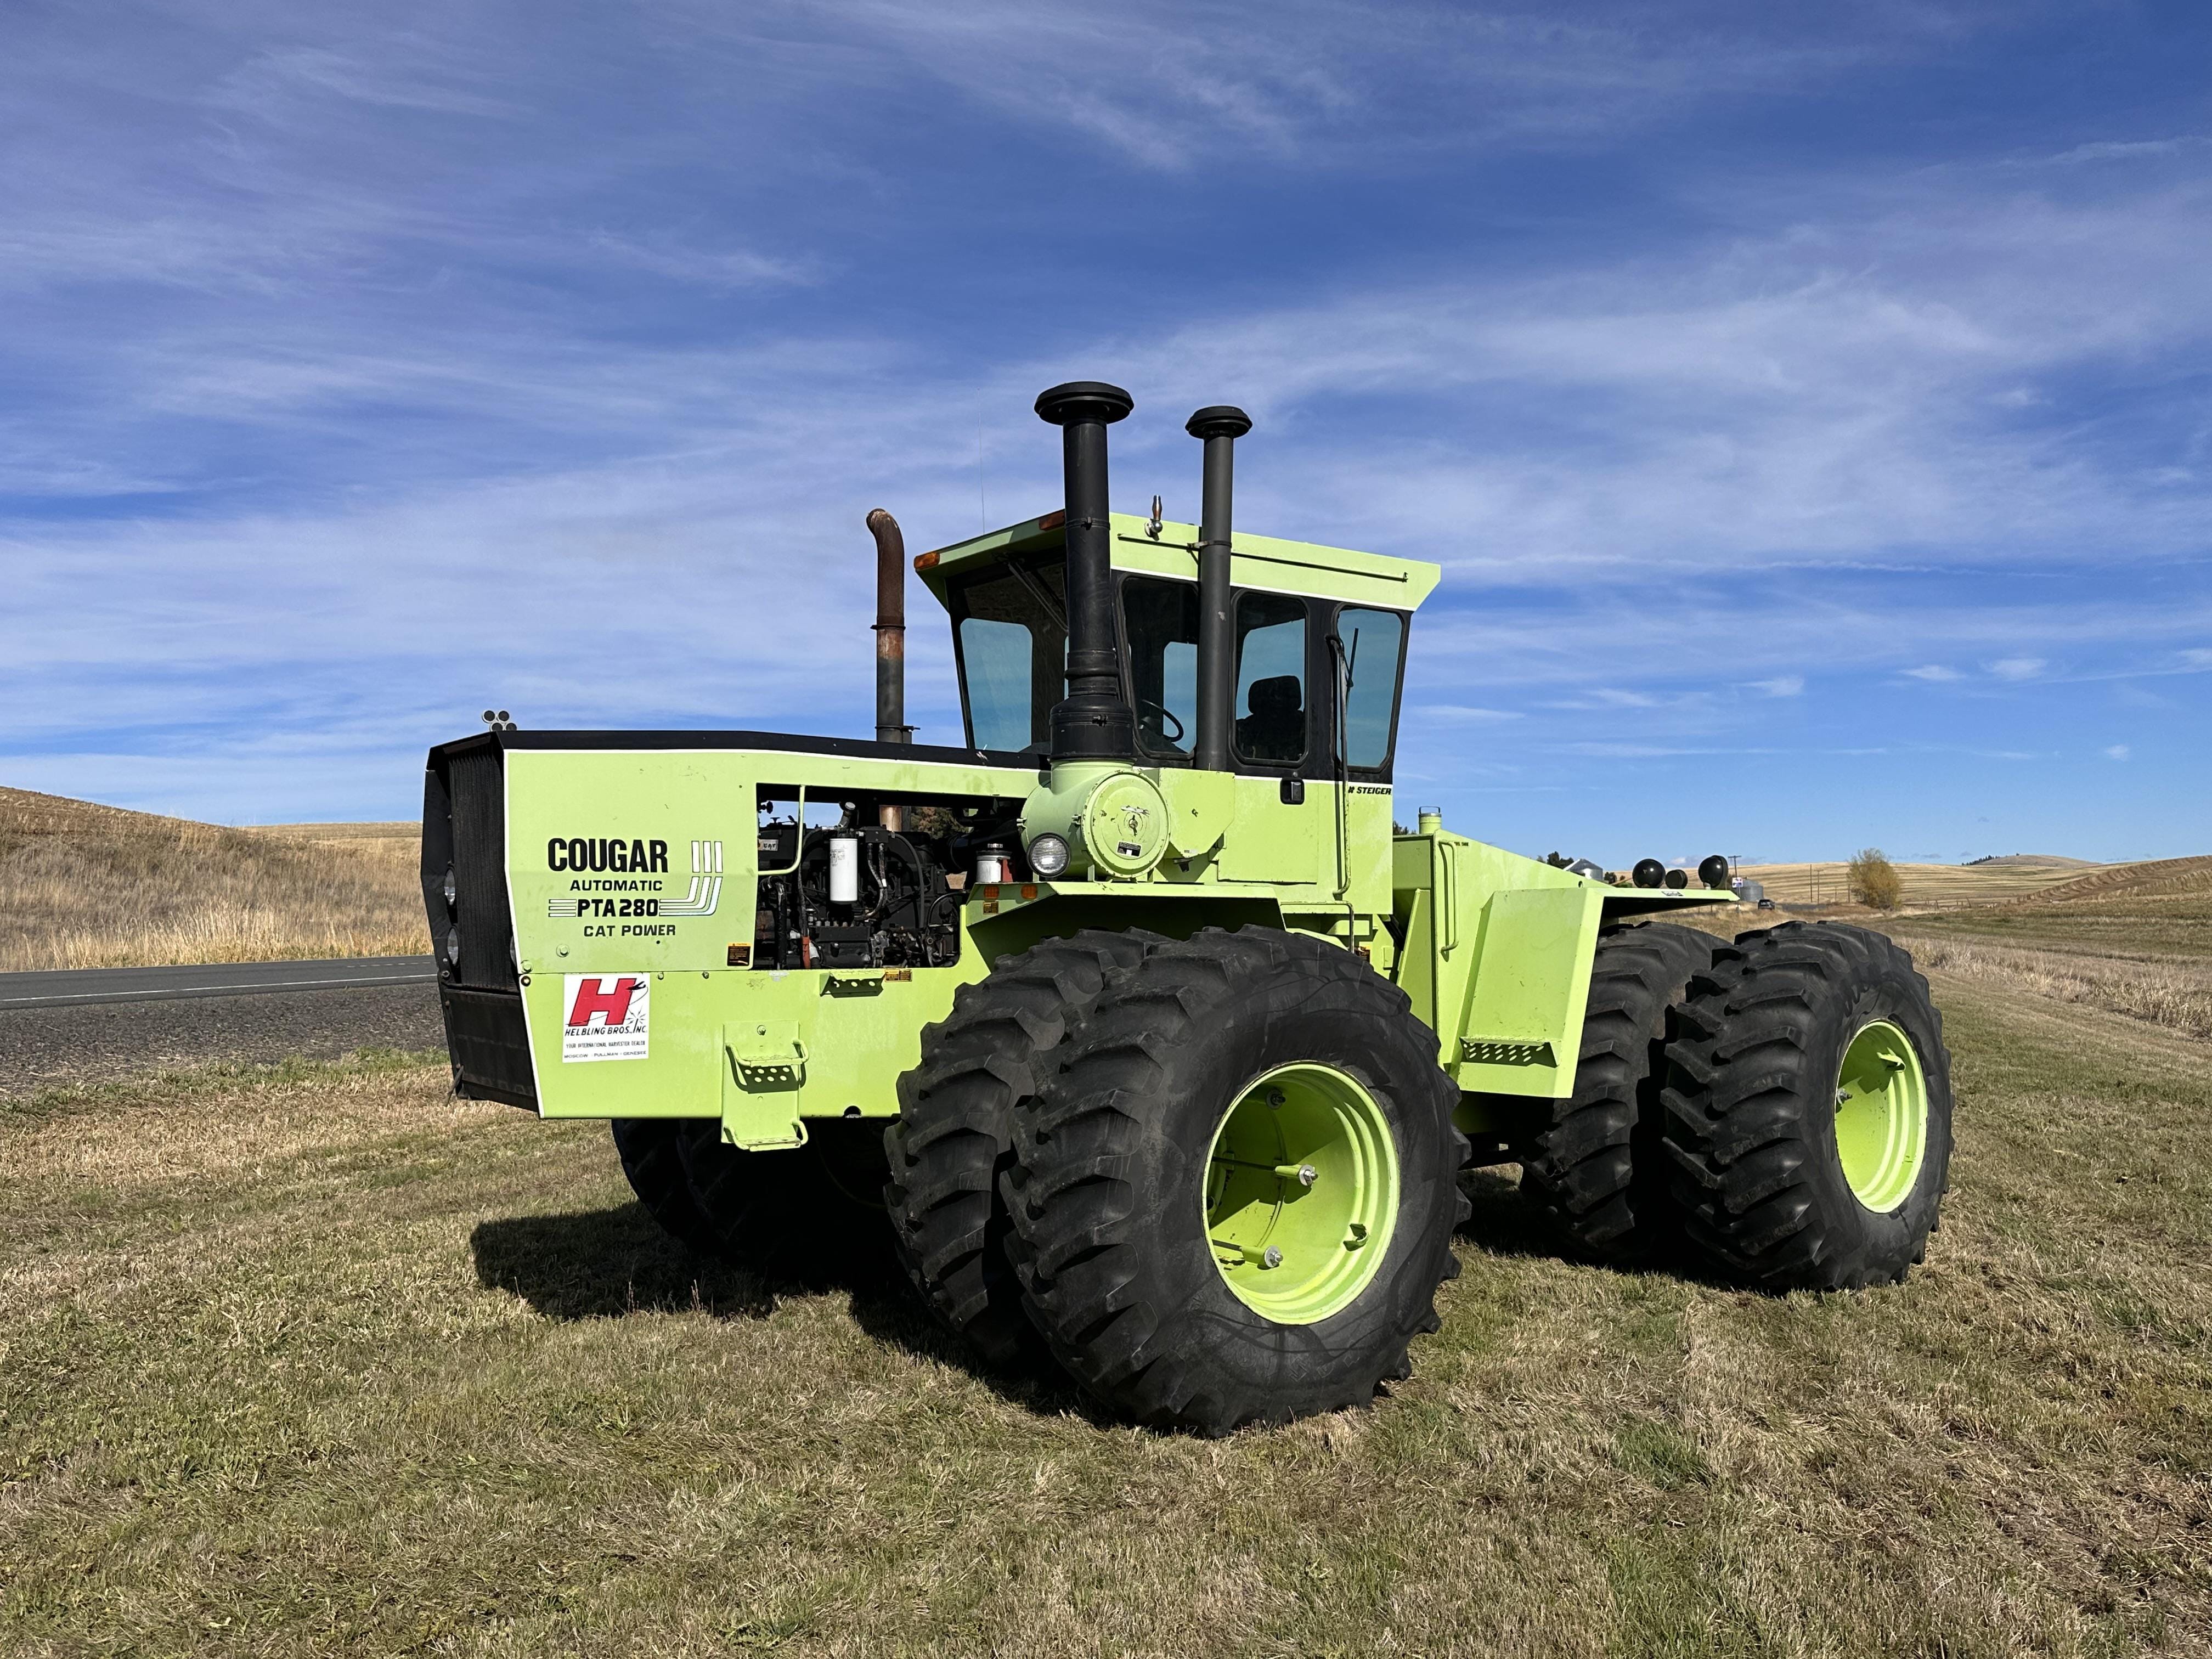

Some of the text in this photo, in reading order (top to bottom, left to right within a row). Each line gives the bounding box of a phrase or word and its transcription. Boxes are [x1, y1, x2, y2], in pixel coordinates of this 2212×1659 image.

[1356, 786, 1392, 795] STEIGER
[548, 838, 668, 873] COUGAR
[570, 880, 663, 891] AUTOMATIC
[584, 925, 675, 936] CAT POWER
[568, 978, 637, 1027] H
[565, 1027, 606, 1036] HELBLING
